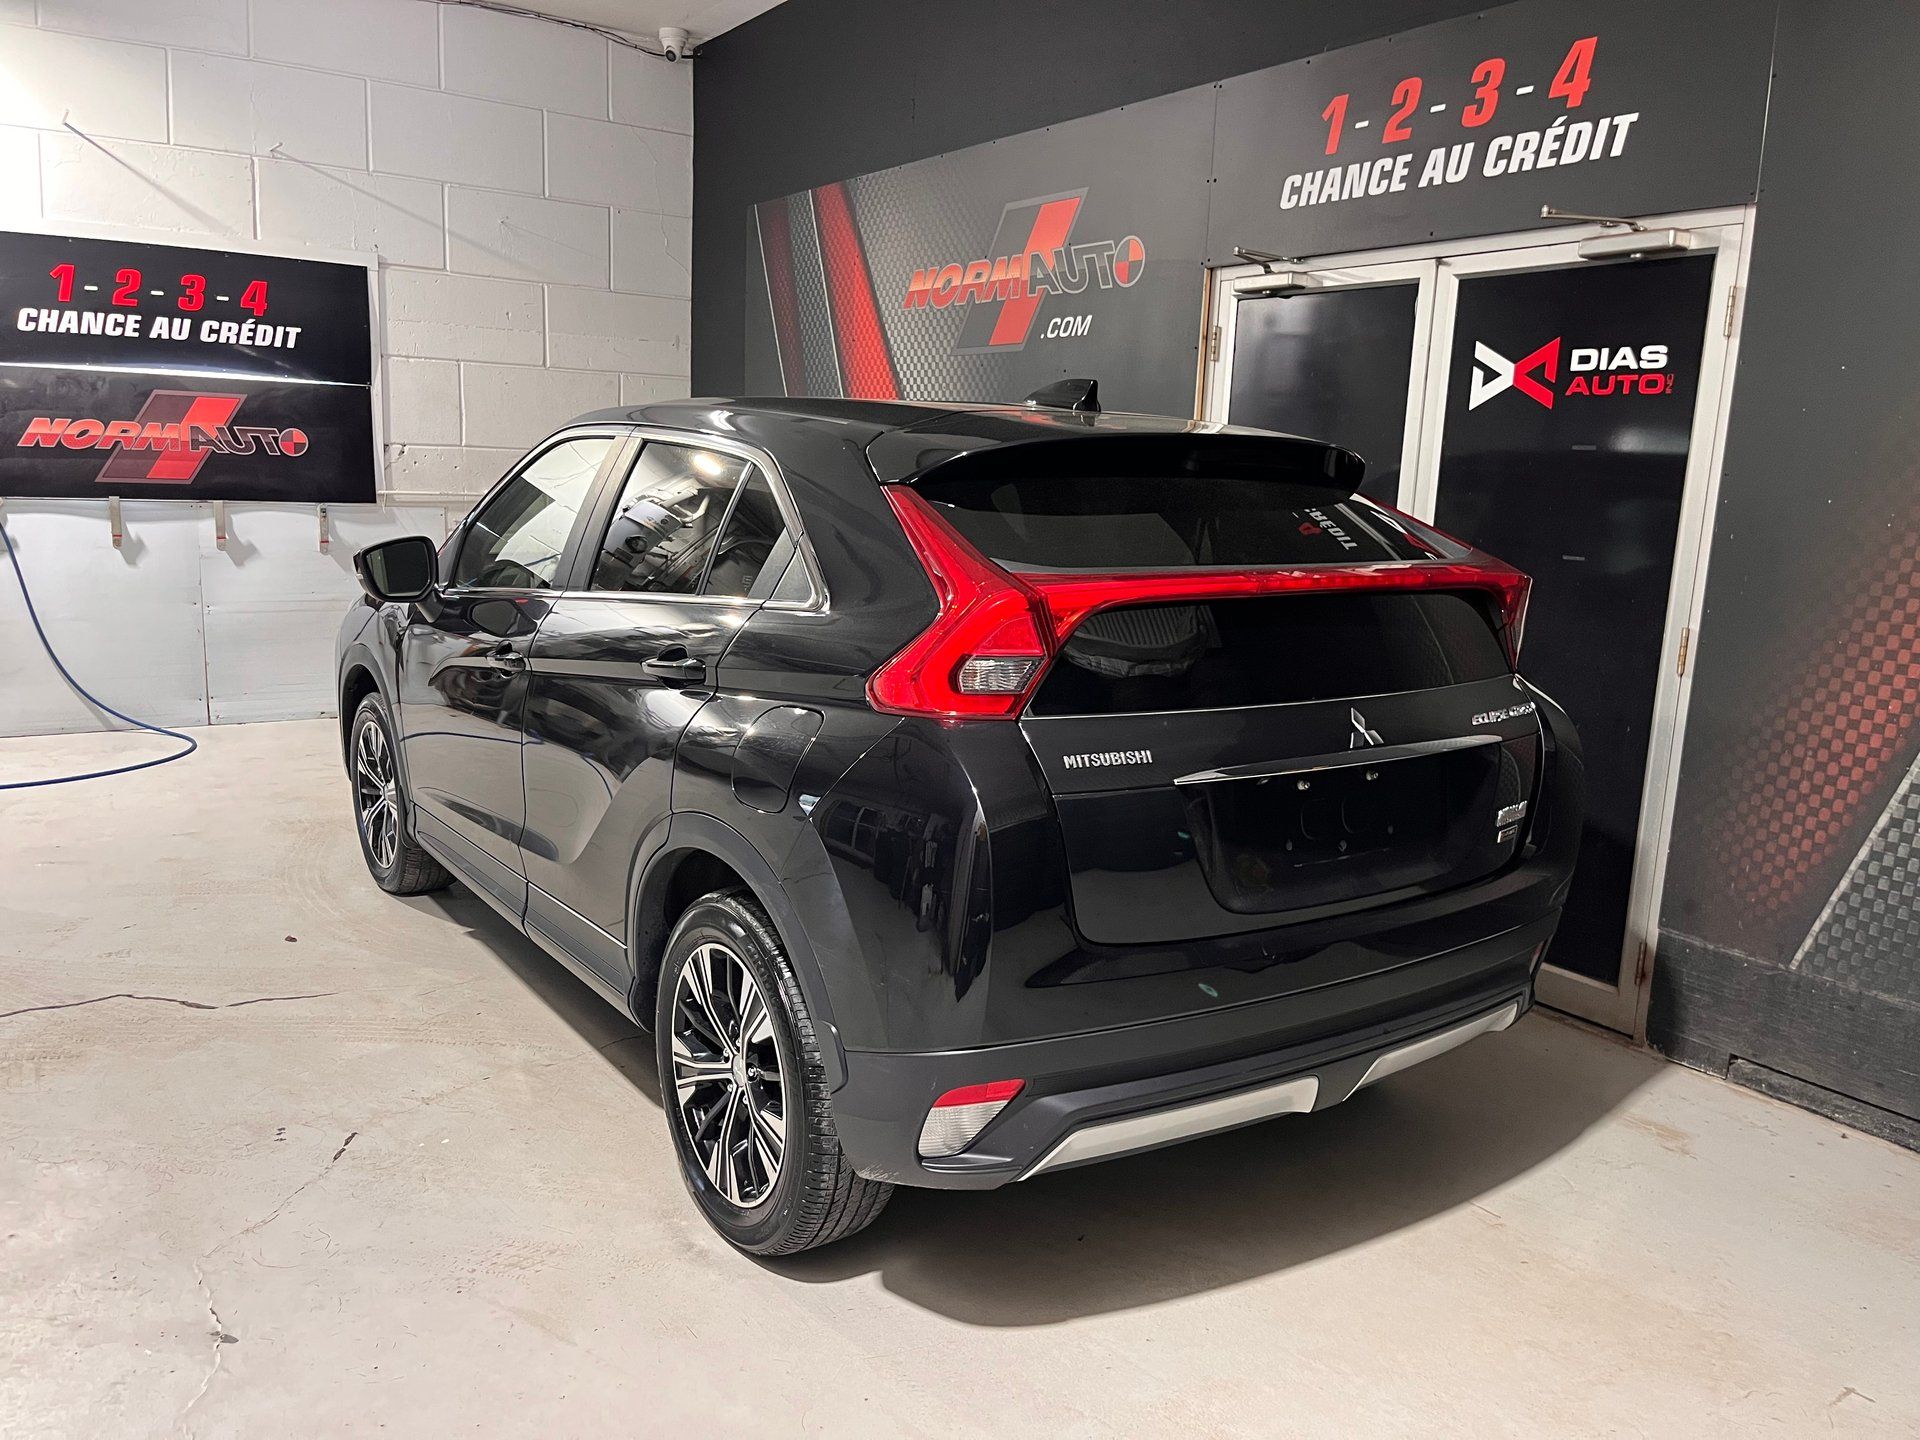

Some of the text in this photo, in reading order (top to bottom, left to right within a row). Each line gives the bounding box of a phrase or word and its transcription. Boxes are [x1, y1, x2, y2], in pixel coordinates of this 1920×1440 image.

[1279, 112, 1640, 210] CHANCE AU CRÉDIT
[17, 307, 301, 349] CHANCE AU CRÉDIT
[1040, 314, 1093, 340] .COM
[1570, 344, 1668, 372] DIAS
[1565, 373, 1665, 396] AUTO
[1062, 750, 1152, 769] MITSUBISHI
